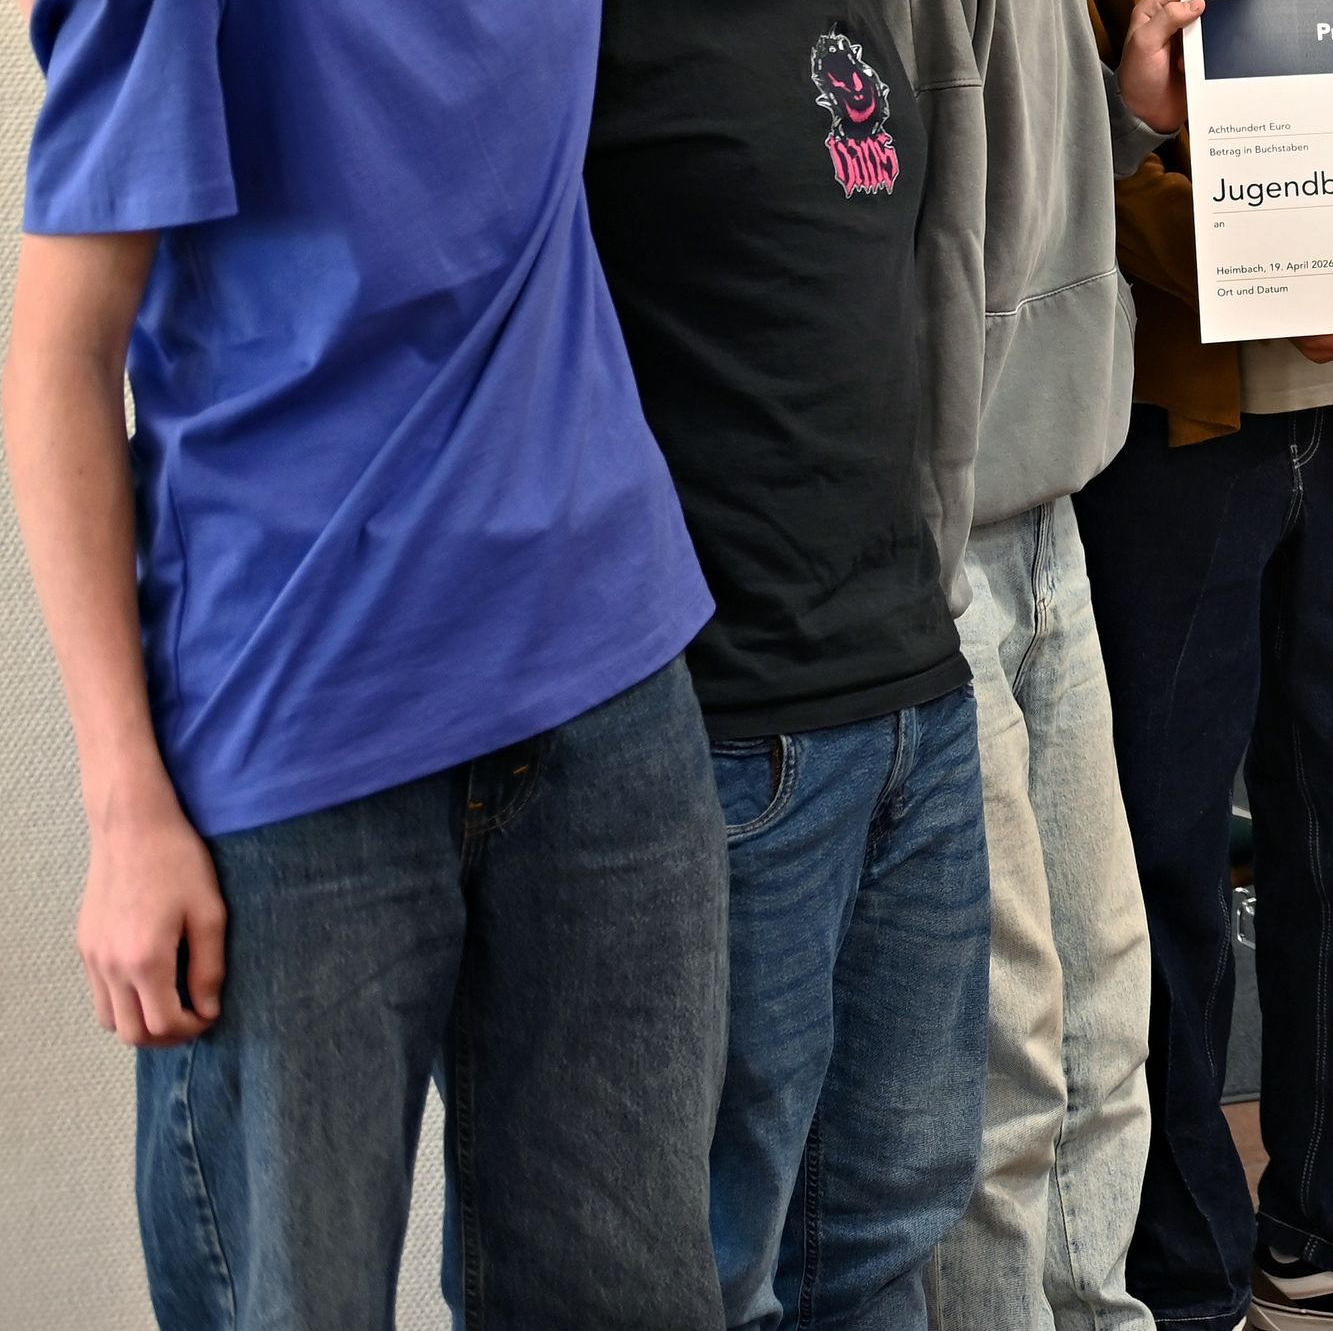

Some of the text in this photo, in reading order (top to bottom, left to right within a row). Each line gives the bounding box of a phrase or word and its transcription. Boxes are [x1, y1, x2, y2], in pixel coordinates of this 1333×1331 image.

[1208, 122, 1291, 134] Achthundert Euro
[1209, 143, 1309, 158] Betrag in Buchstaben
[1216, 263, 1267, 276] Heimbach,
[1270, 262, 1284, 272] 19.
[1286, 261, 1309, 273] April
[1217, 285, 1289, 297] Ort und Datum
